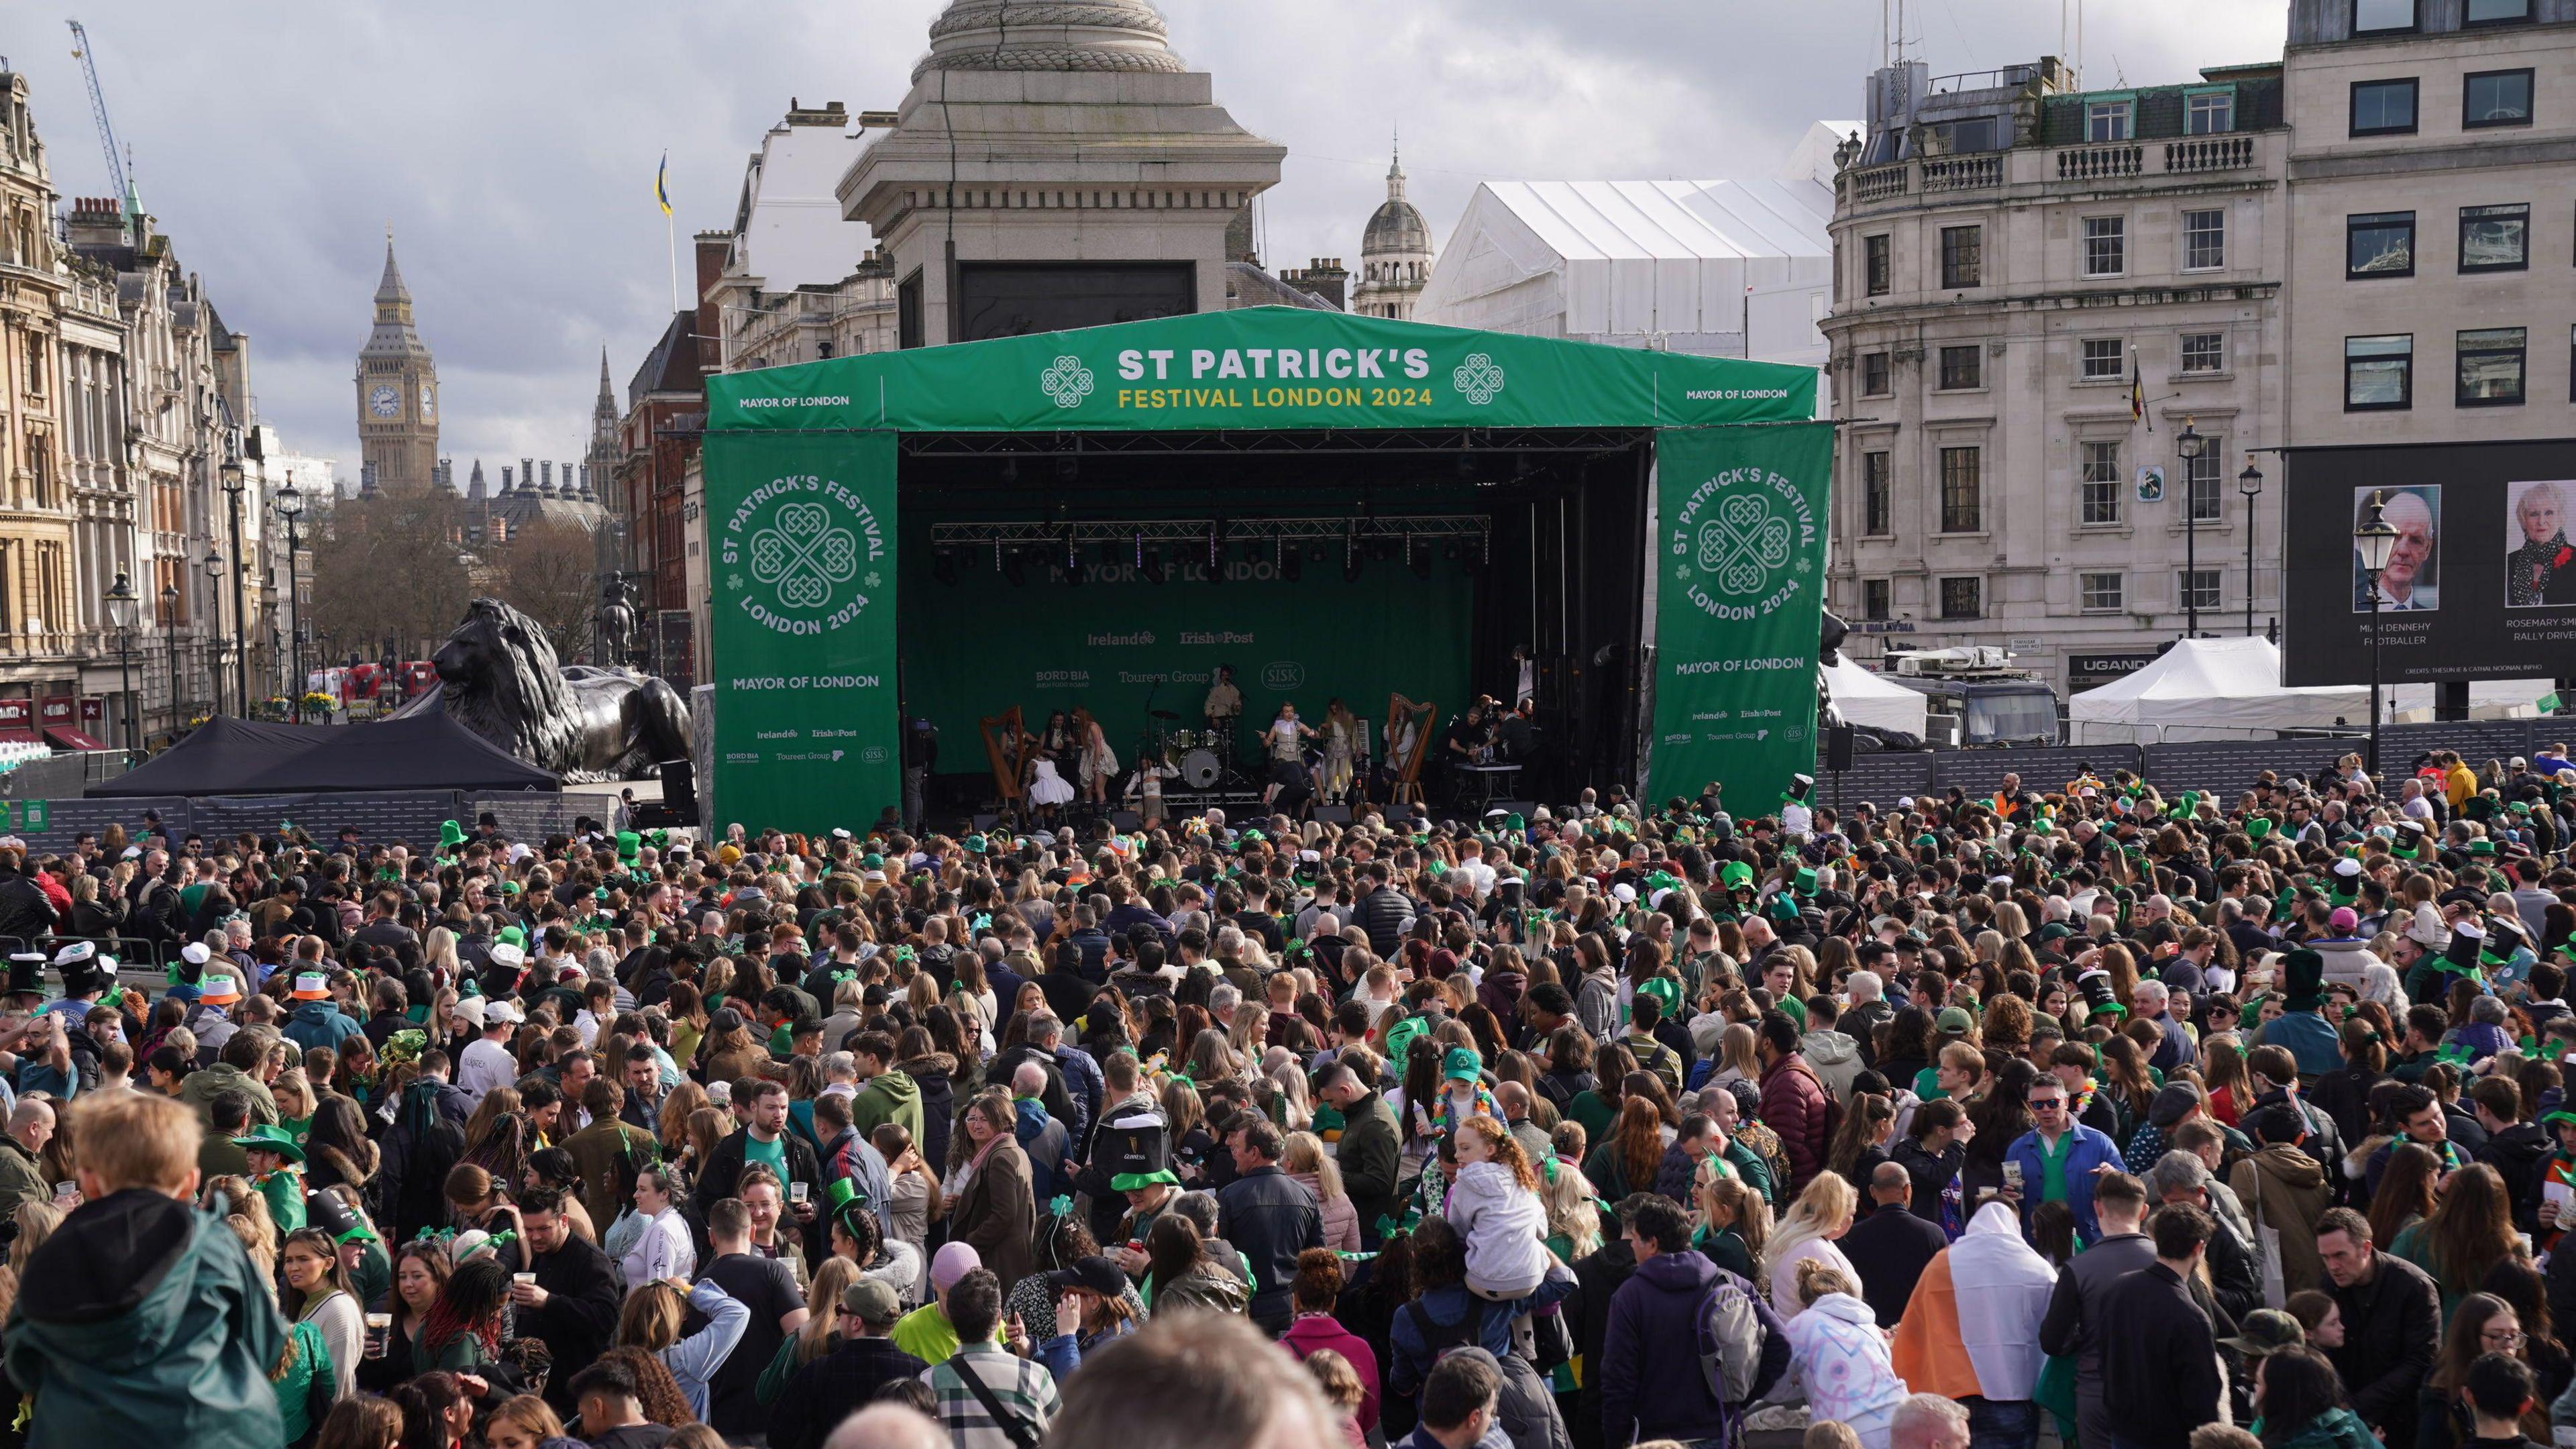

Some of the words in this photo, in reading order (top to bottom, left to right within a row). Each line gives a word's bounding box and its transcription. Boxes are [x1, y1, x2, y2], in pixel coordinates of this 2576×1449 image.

[1118, 349, 1174, 380] ST
[1191, 348, 1430, 379] PATRICK'S
[1119, 388, 1242, 409] FESTIVAL
[1252, 387, 1361, 407] LONDON
[1371, 388, 1432, 407] 2024
[1686, 390, 1723, 400] MAYOR
[1725, 390, 1739, 399] OF
[1741, 389, 1787, 398] LONDON
[740, 398, 780, 408] MAYOR
[782, 397, 798, 407] OF
[800, 396, 849, 407] LONDON
[1678, 468, 1761, 525] PATRICK'S
[728, 475, 818, 533] PATRICK'S
[1766, 472, 1815, 547] FESTIVAL
[824, 480, 884, 561] FESTIVAL
[1673, 529, 1688, 555] ST
[722, 537, 739, 564] ST
[1686, 584, 1756, 621] LONDON
[1760, 578, 1799, 614] 2024
[740, 595, 821, 635] LONDON
[827, 593, 869, 630] 2024
[2386, 623, 2431, 632] DENNEHY
[2506, 618, 2559, 628] ROSEMARY
[1087, 632, 1140, 646] Ireland
[1180, 631, 1215, 645] Irish
[1223, 631, 1254, 644] Post
[2514, 632, 2544, 641] RALLY
[2547, 631, 2576, 640] DRIVE
[1676, 661, 1720, 675] MAYOR
[1723, 660, 1741, 672] OF
[1744, 657, 1803, 670] LONDON
[2084, 660, 2154, 670] UGAND
[1036, 671, 1069, 681] BORD
[1071, 671, 1089, 680] BIA
[1118, 671, 1168, 684] Toureen
[1172, 671, 1210, 685] Group
[1268, 669, 1297, 682] SISK
[733, 677, 786, 690] MAYOR
[789, 676, 808, 688] OF
[813, 676, 879, 688] LONDON
[1693, 711, 1721, 720] Ireland
[1741, 710, 1760, 718] Irish
[1764, 709, 1782, 717] Post
[757, 730, 790, 739] Ireland
[812, 729, 834, 737] Irish
[838, 729, 857, 737] Post
[1788, 729, 1803, 738] SISK
[776, 753, 806, 761] Toureen
[808, 752, 830, 760] Group
[865, 750, 884, 759] SISK
